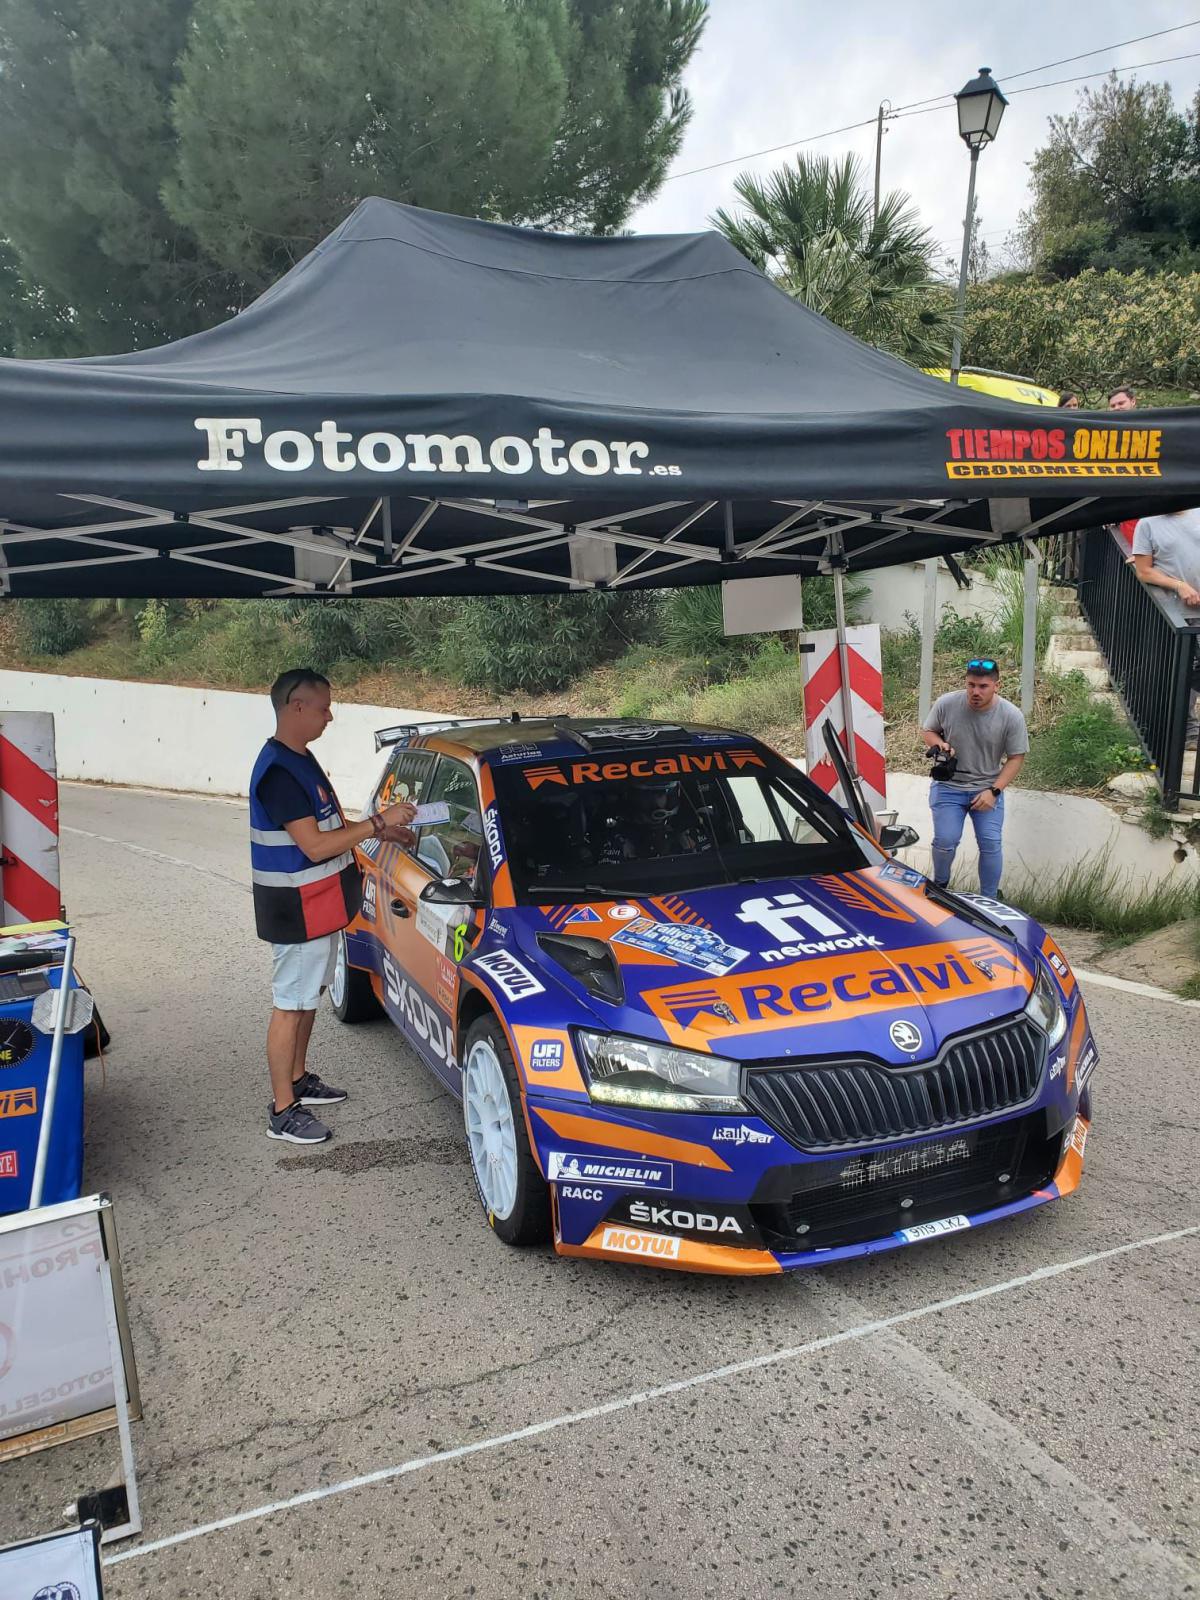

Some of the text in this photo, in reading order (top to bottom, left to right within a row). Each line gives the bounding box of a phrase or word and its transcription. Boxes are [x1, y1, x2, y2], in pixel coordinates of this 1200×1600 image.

[945, 428, 1162, 460] TIEMPOS ONLINE
[952, 463, 1155, 477] CRONOMETRAJE
[570, 751, 729, 784] Recalvi
[484, 807, 503, 871] ŠKODA
[734, 893, 847, 943] fi
[454, 923, 468, 963] 6
[759, 932, 884, 963] network
[479, 953, 538, 996] MOTUL
[738, 954, 974, 1021] Recalvi
[532, 1058, 561, 1067] FILTERS
[533, 1044, 561, 1058] UFI
[583, 1163, 663, 1182] MICHELIN
[562, 1186, 603, 1202] RACC
[629, 1201, 744, 1234] ŠKODA
[909, 1216, 966, 1238] 9119 LKZ
[605, 1231, 675, 1256] MOTUL
